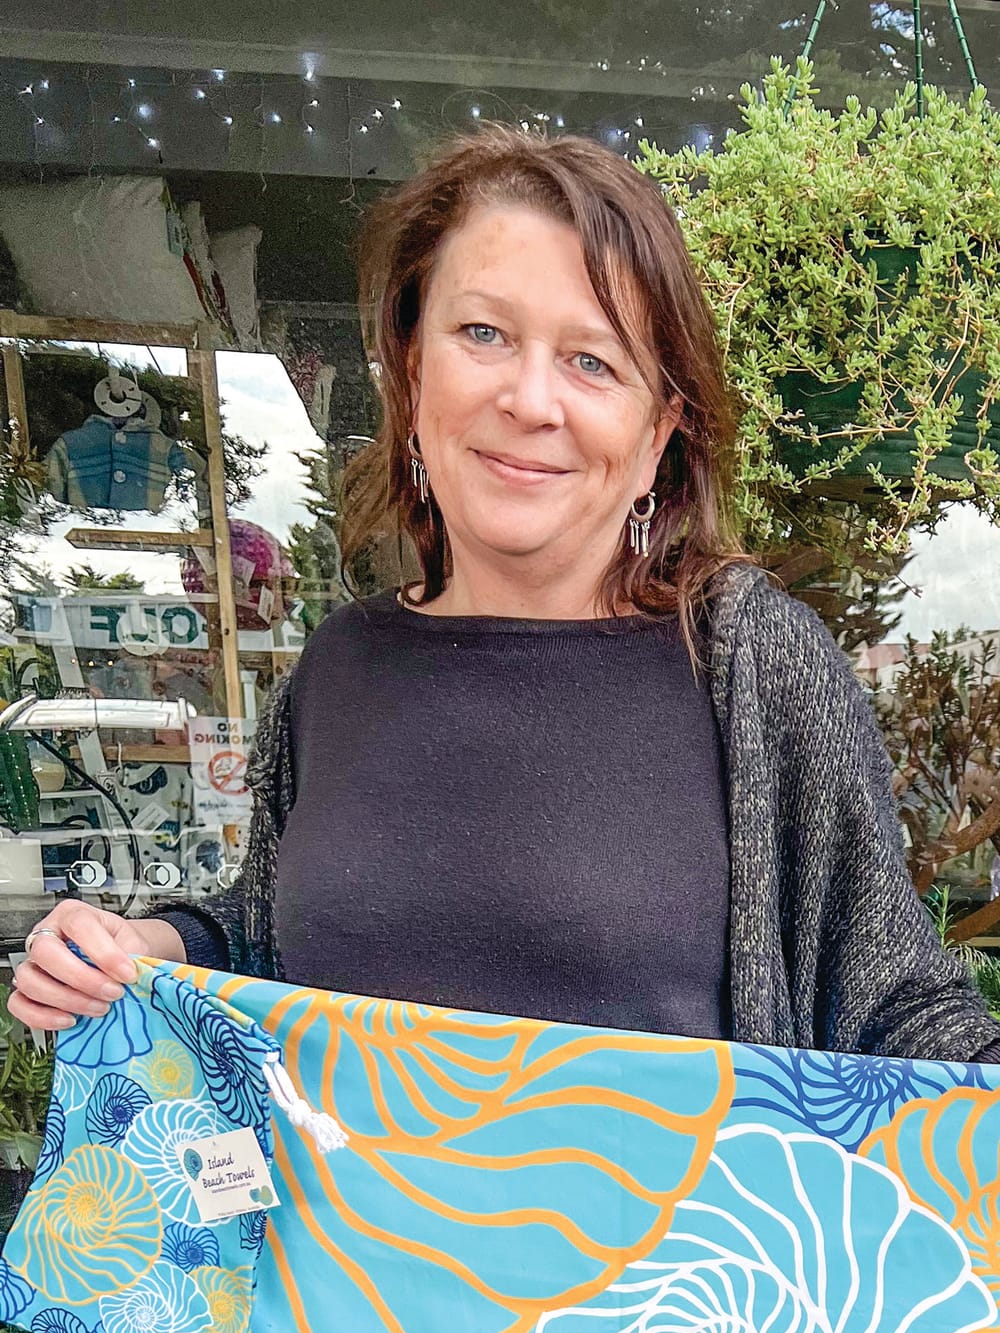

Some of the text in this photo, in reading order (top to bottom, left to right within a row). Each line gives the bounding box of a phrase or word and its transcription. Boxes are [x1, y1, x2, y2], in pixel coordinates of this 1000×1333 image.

[208, 1152, 235, 1170] Island
[202, 1171, 225, 1188] Beach
[226, 1165, 255, 1183] Towels
